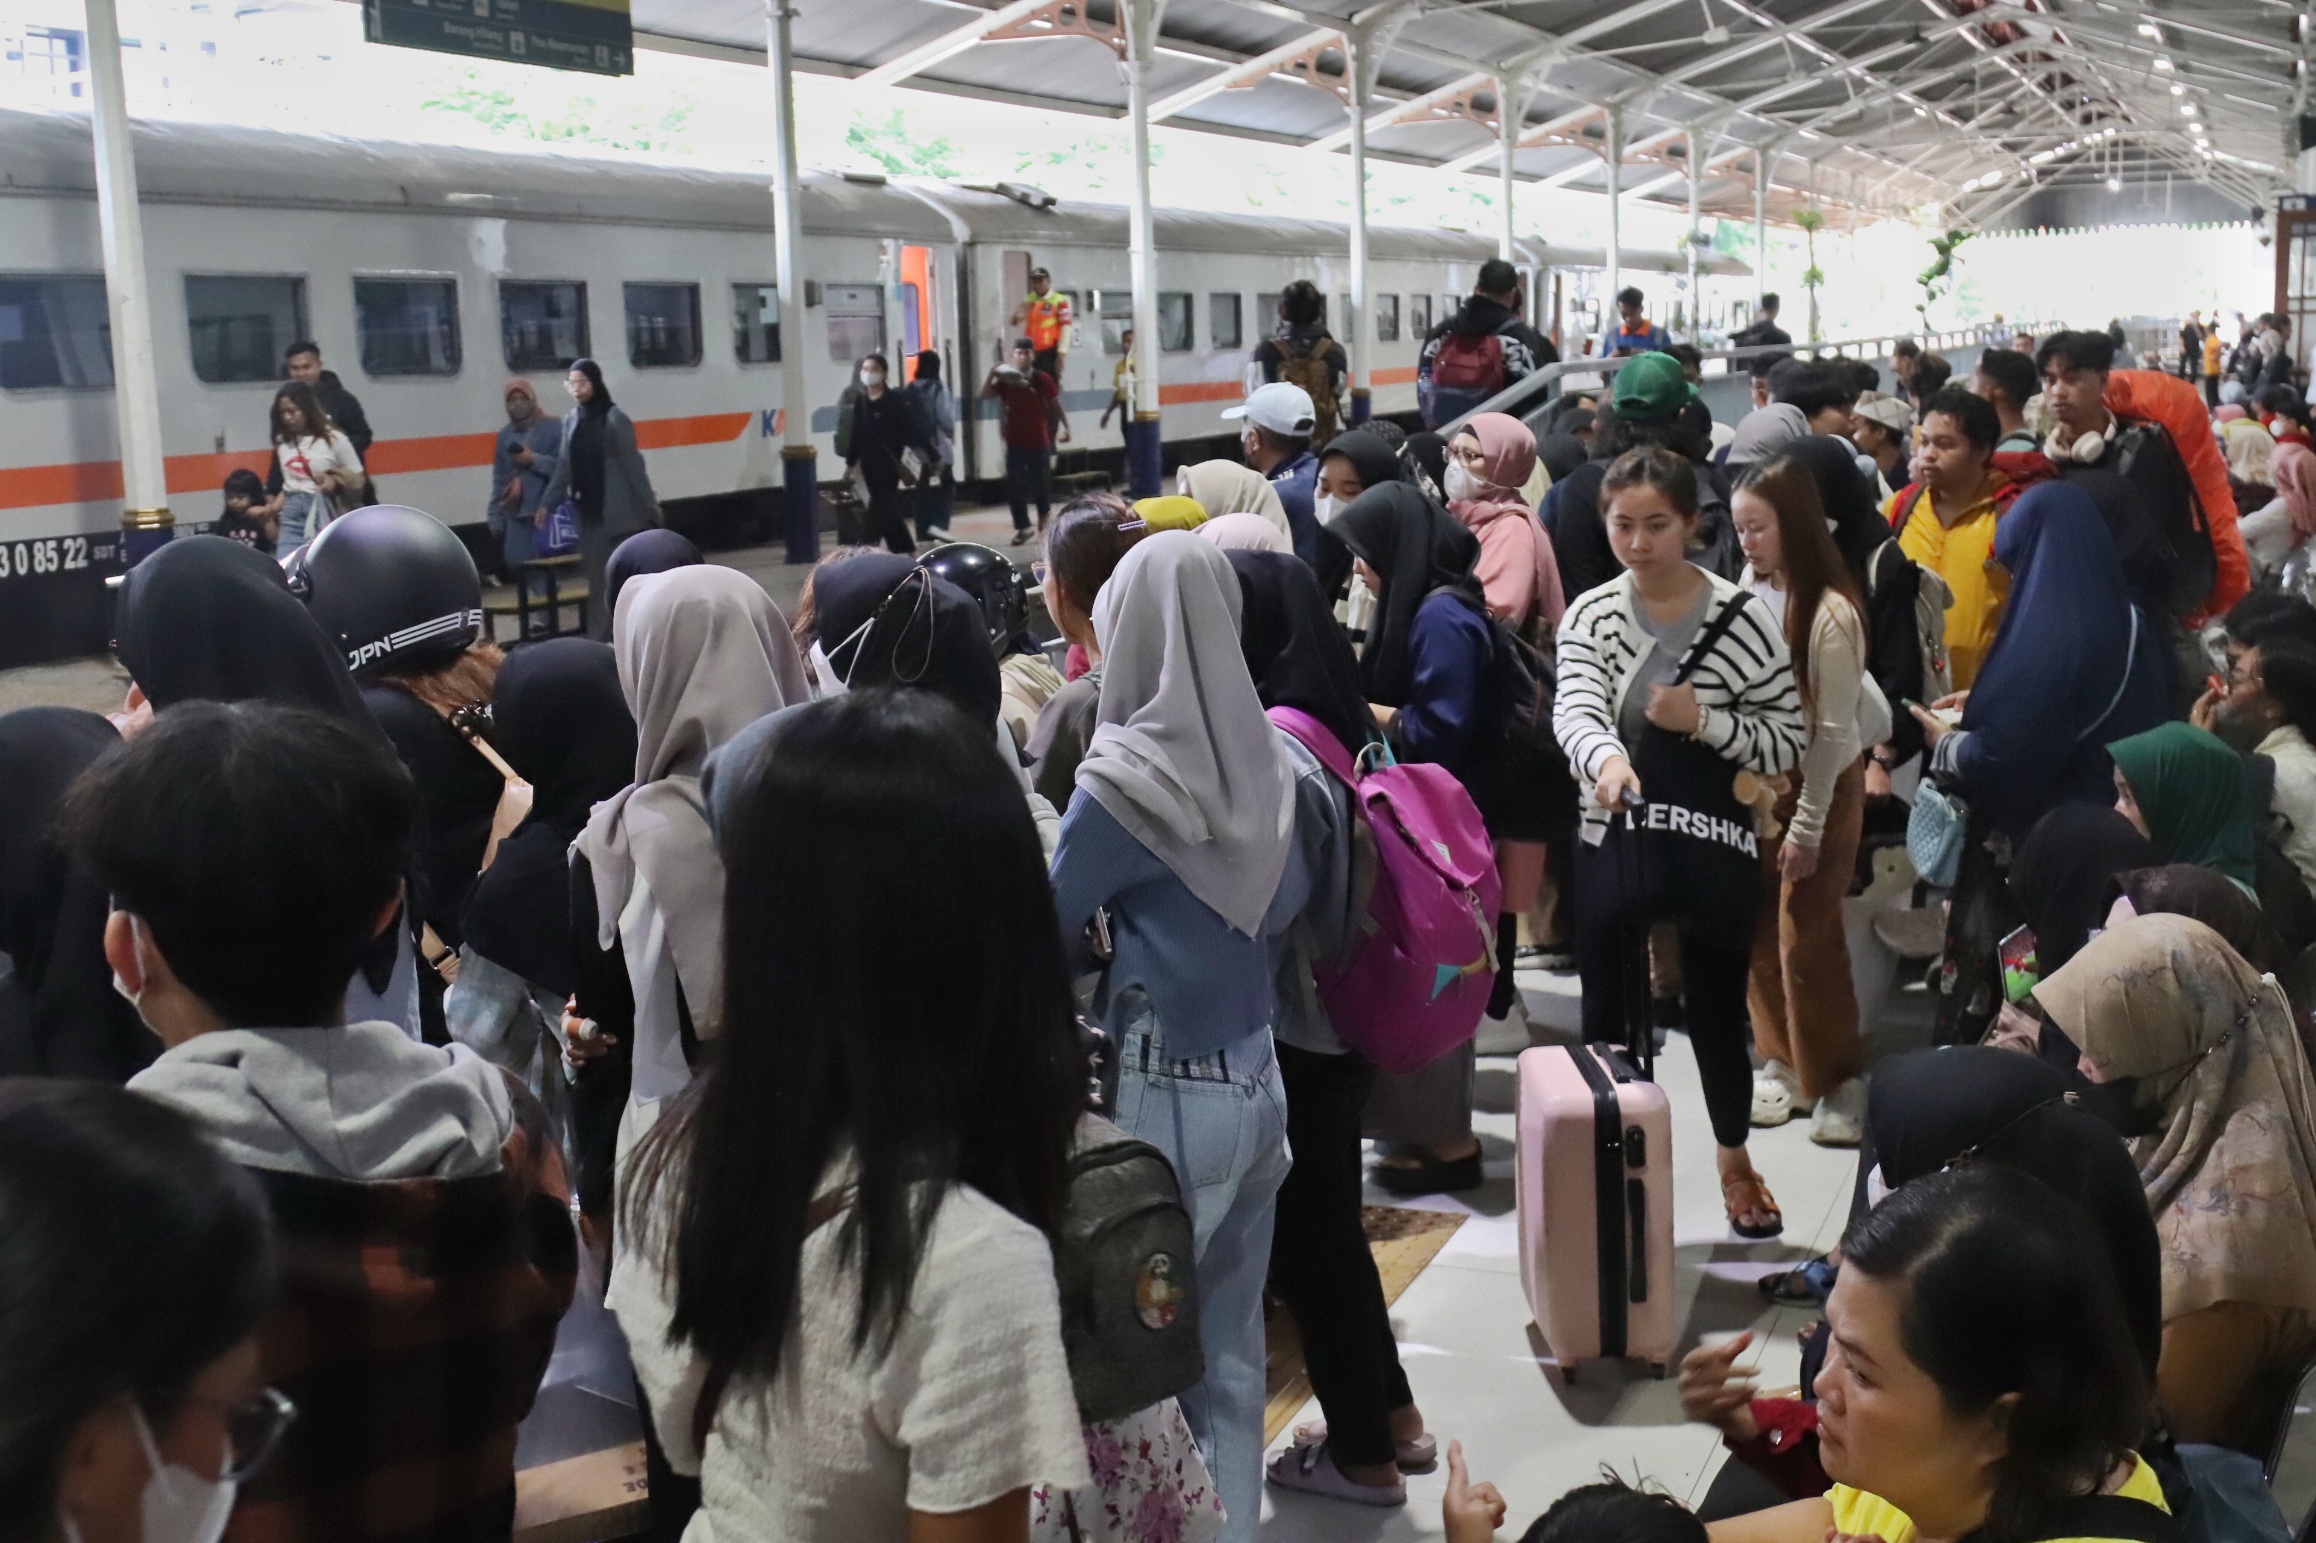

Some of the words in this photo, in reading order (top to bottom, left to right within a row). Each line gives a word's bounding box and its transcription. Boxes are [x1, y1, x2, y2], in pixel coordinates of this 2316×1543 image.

[14, 543, 29, 576] 0
[33, 540, 59, 574] 85
[63, 537, 89, 570] 22
[348, 636, 392, 671] JPN
